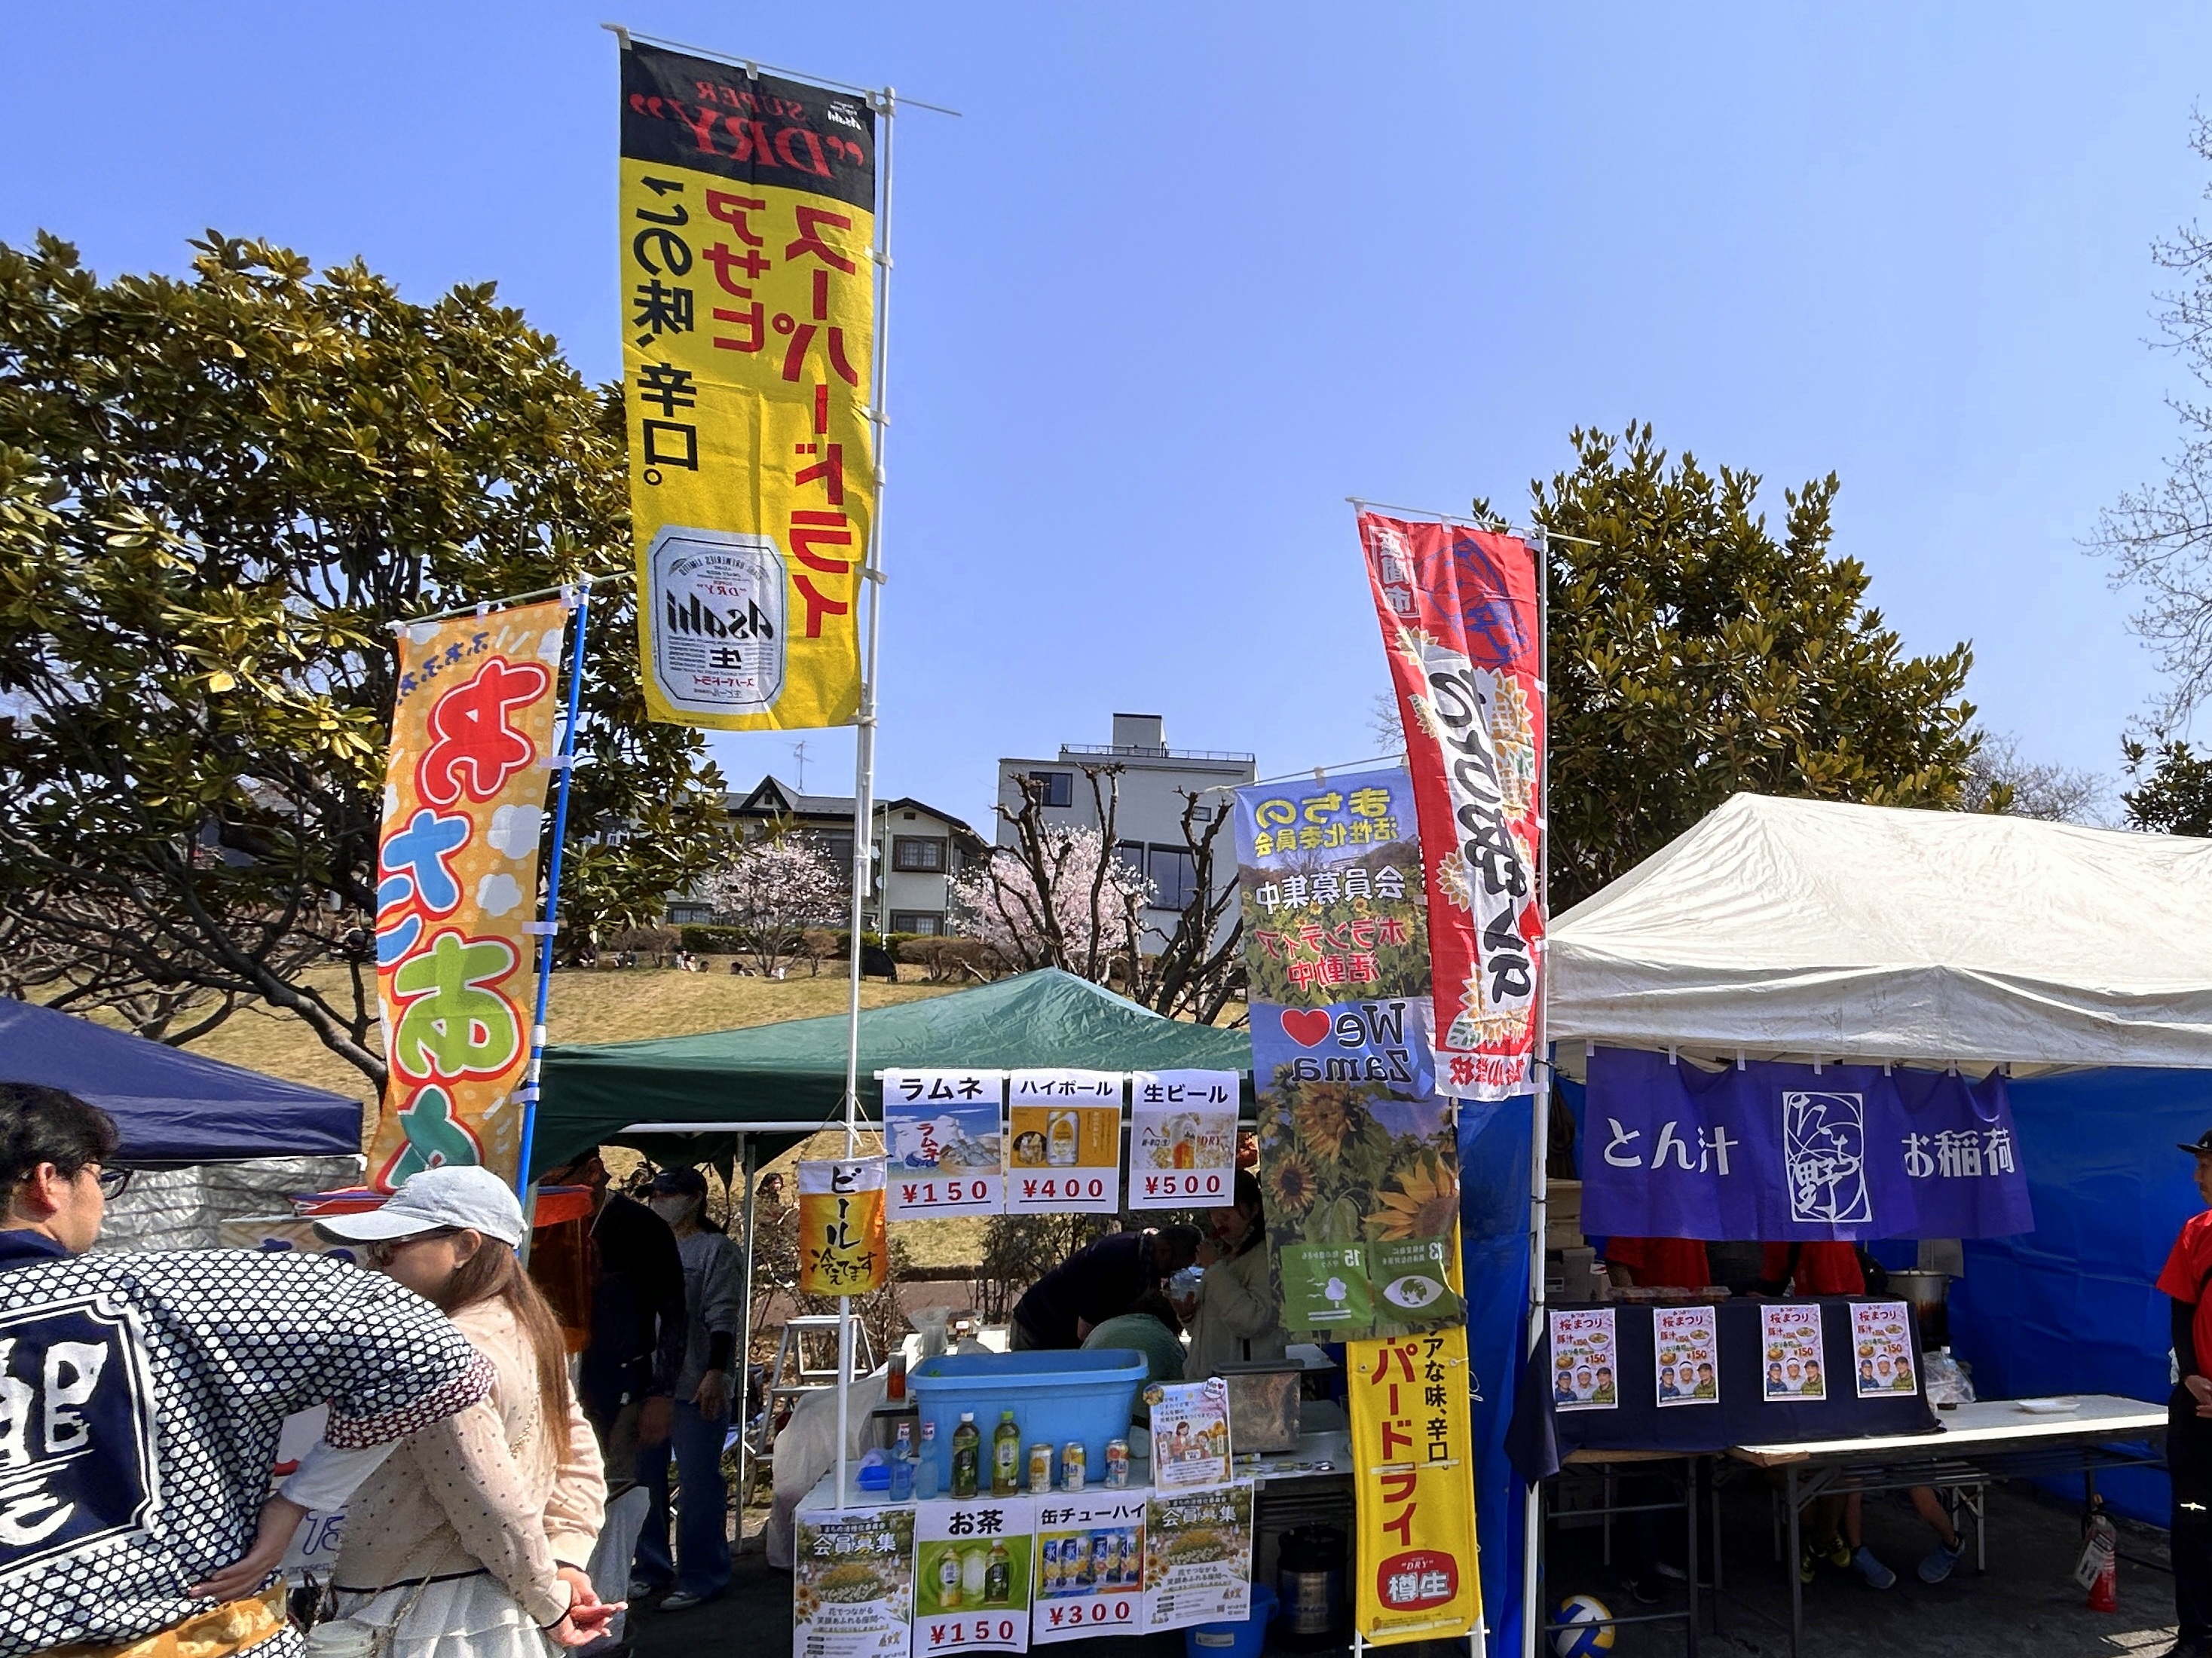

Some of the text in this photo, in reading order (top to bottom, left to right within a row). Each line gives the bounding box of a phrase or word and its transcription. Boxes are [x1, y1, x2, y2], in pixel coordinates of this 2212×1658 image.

[899, 1077, 984, 1101] ラムネ
[1020, 1079, 1113, 1097] ハイボール
[1143, 1083, 1228, 1104] 生ビール
[916, 1122, 940, 1161] ラムネ
[1603, 1117, 1739, 1176] とん汁
[1901, 1127, 2015, 1178] お稲荷
[902, 1179, 988, 1204] ¥150
[1022, 1178, 1103, 1198] ¥400
[1145, 1175, 1220, 1195] ¥500
[827, 1165, 862, 1250] ビール
[810, 1247, 878, 1286] 冷えてます
[1559, 1317, 1602, 1331] 桜まつり
[1662, 1315, 1703, 1327] 桜まつり
[1770, 1313, 1809, 1323] 桜まつり
[1859, 1310, 1896, 1322] 桜まつり
[1585, 1354, 1606, 1363] ¥150
[1687, 1349, 1707, 1360] ¥150
[1794, 1347, 1813, 1357] ¥150
[1883, 1343, 1902, 1354] ¥150
[948, 1509, 1004, 1535] お茶
[1042, 1503, 1145, 1525] 缶チューハイ
[1161, 1505, 1237, 1528] 会員募集
[812, 1531, 897, 1556] 会員募集
[1177, 1566, 1218, 1576] 花でつながる
[1387, 1571, 1451, 1604] 樽生
[828, 1607, 873, 1615] 花でつながる
[1049, 1600, 1130, 1626] ¥300
[930, 1620, 1014, 1644] ¥150
